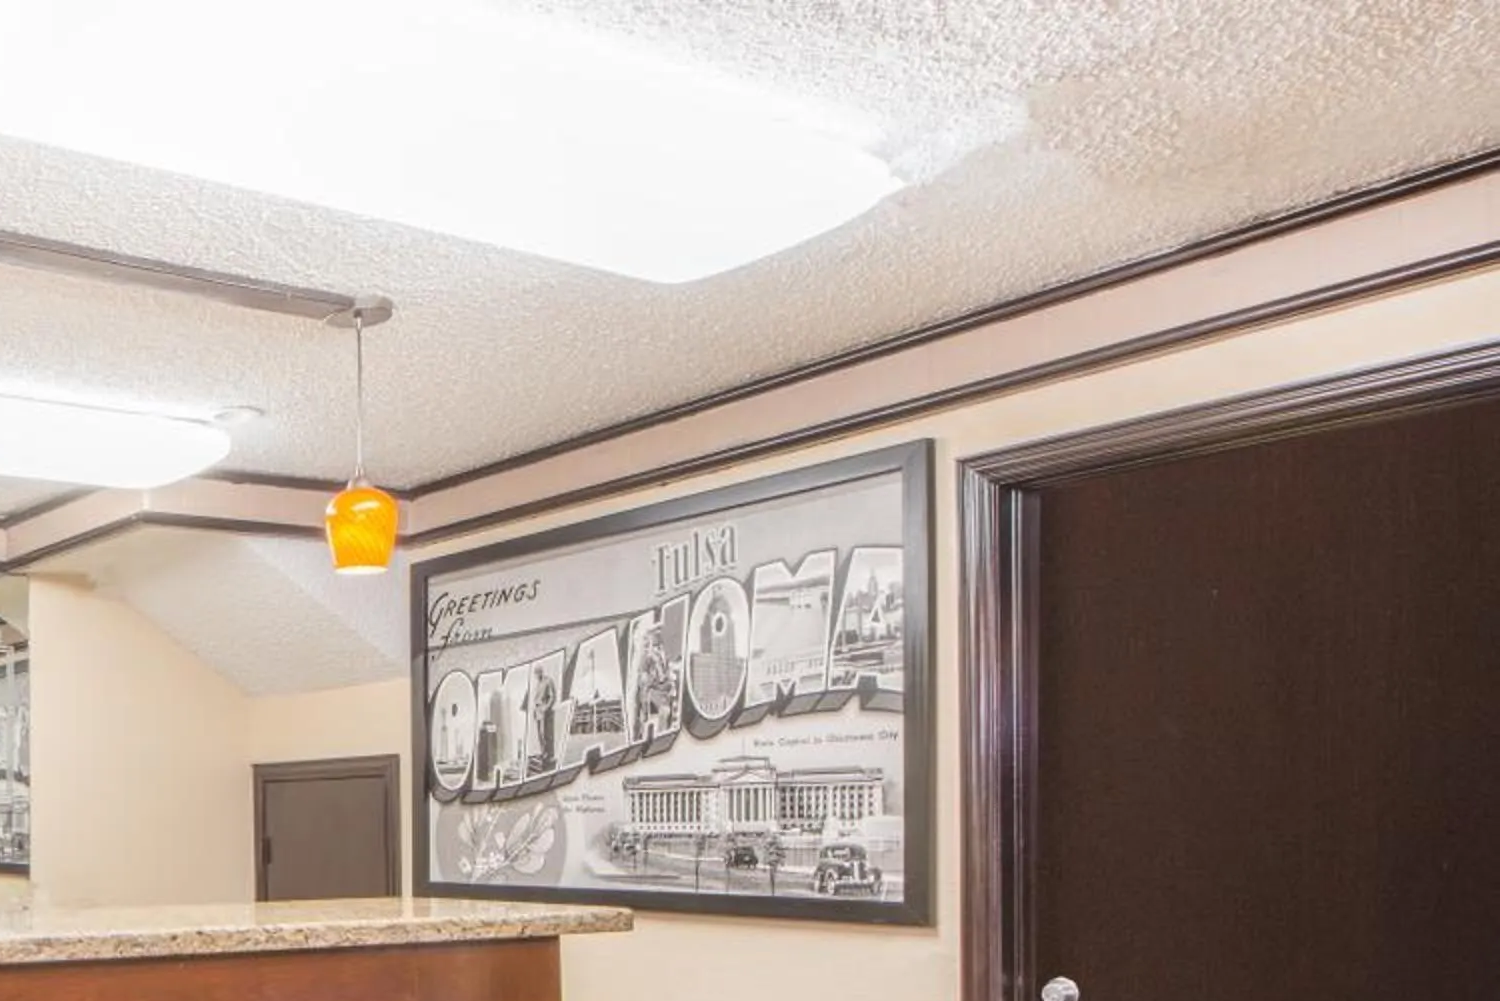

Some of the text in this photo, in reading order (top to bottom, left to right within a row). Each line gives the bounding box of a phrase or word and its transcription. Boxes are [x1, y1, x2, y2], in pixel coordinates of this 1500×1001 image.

[651, 525, 739, 597] Tulsa
[429, 579, 541, 637] GREETINGS
[431, 617, 493, 661] from
[430, 545, 904, 805] OKLAHOMA
